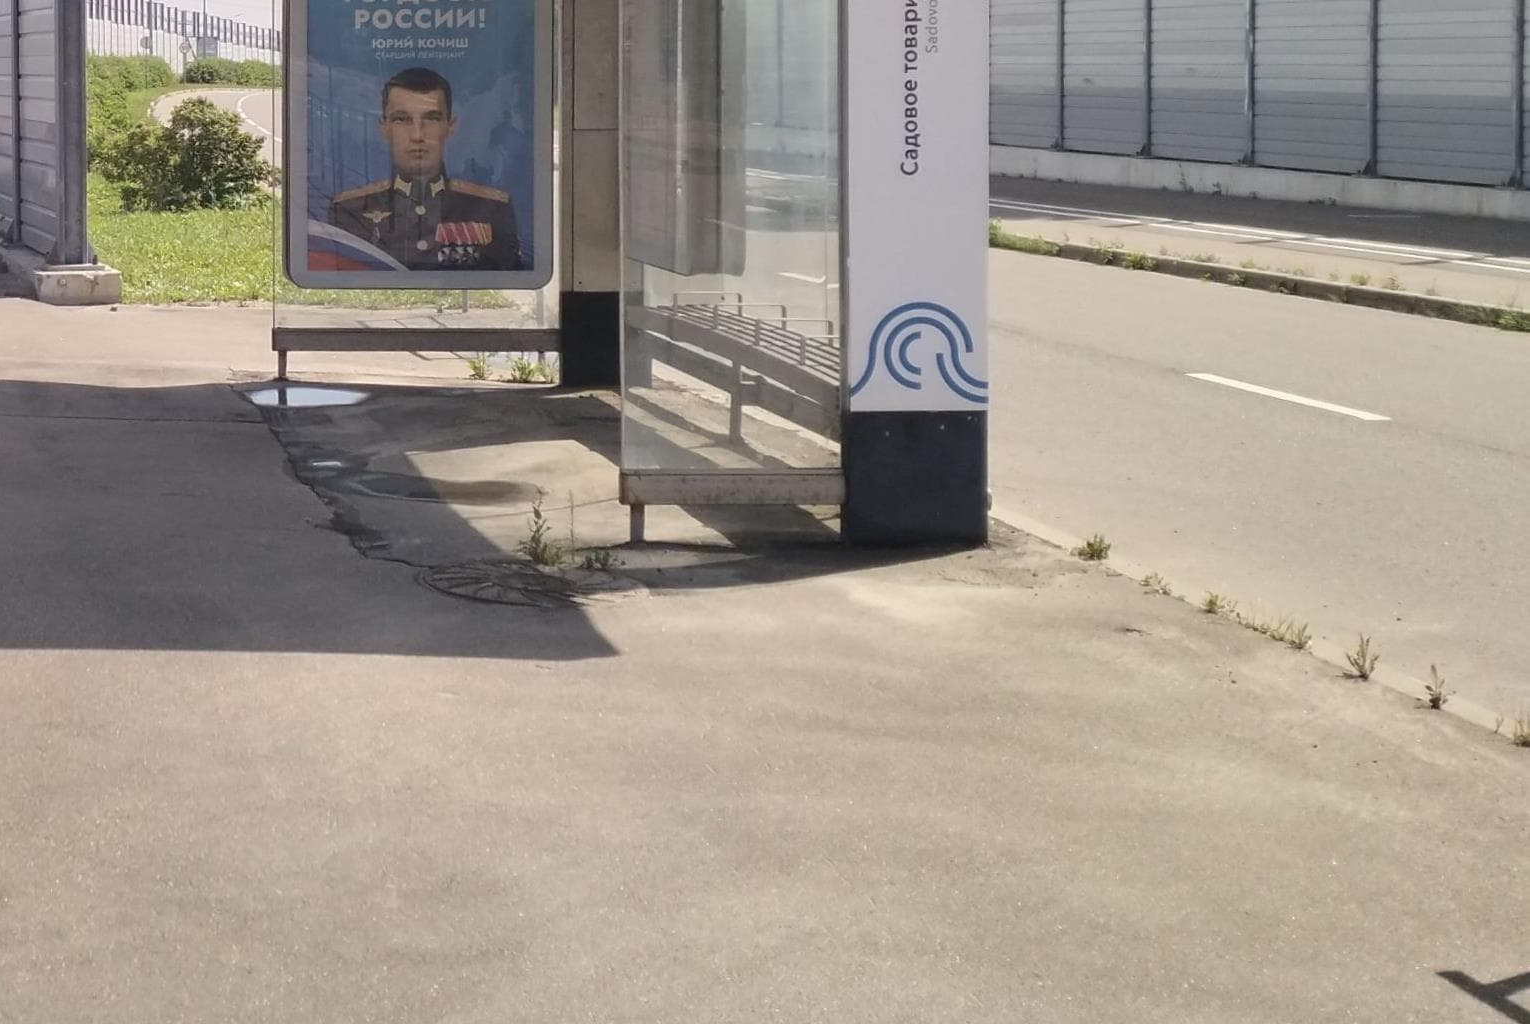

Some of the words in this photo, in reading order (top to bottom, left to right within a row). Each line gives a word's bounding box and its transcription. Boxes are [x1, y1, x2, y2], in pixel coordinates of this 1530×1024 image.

[354, 8, 487, 29] РОССИИ!
[372, 36, 414, 49] ЮРИЙ
[418, 38, 469, 48] КОЧИШ
[900, 79, 921, 176] Садовое
